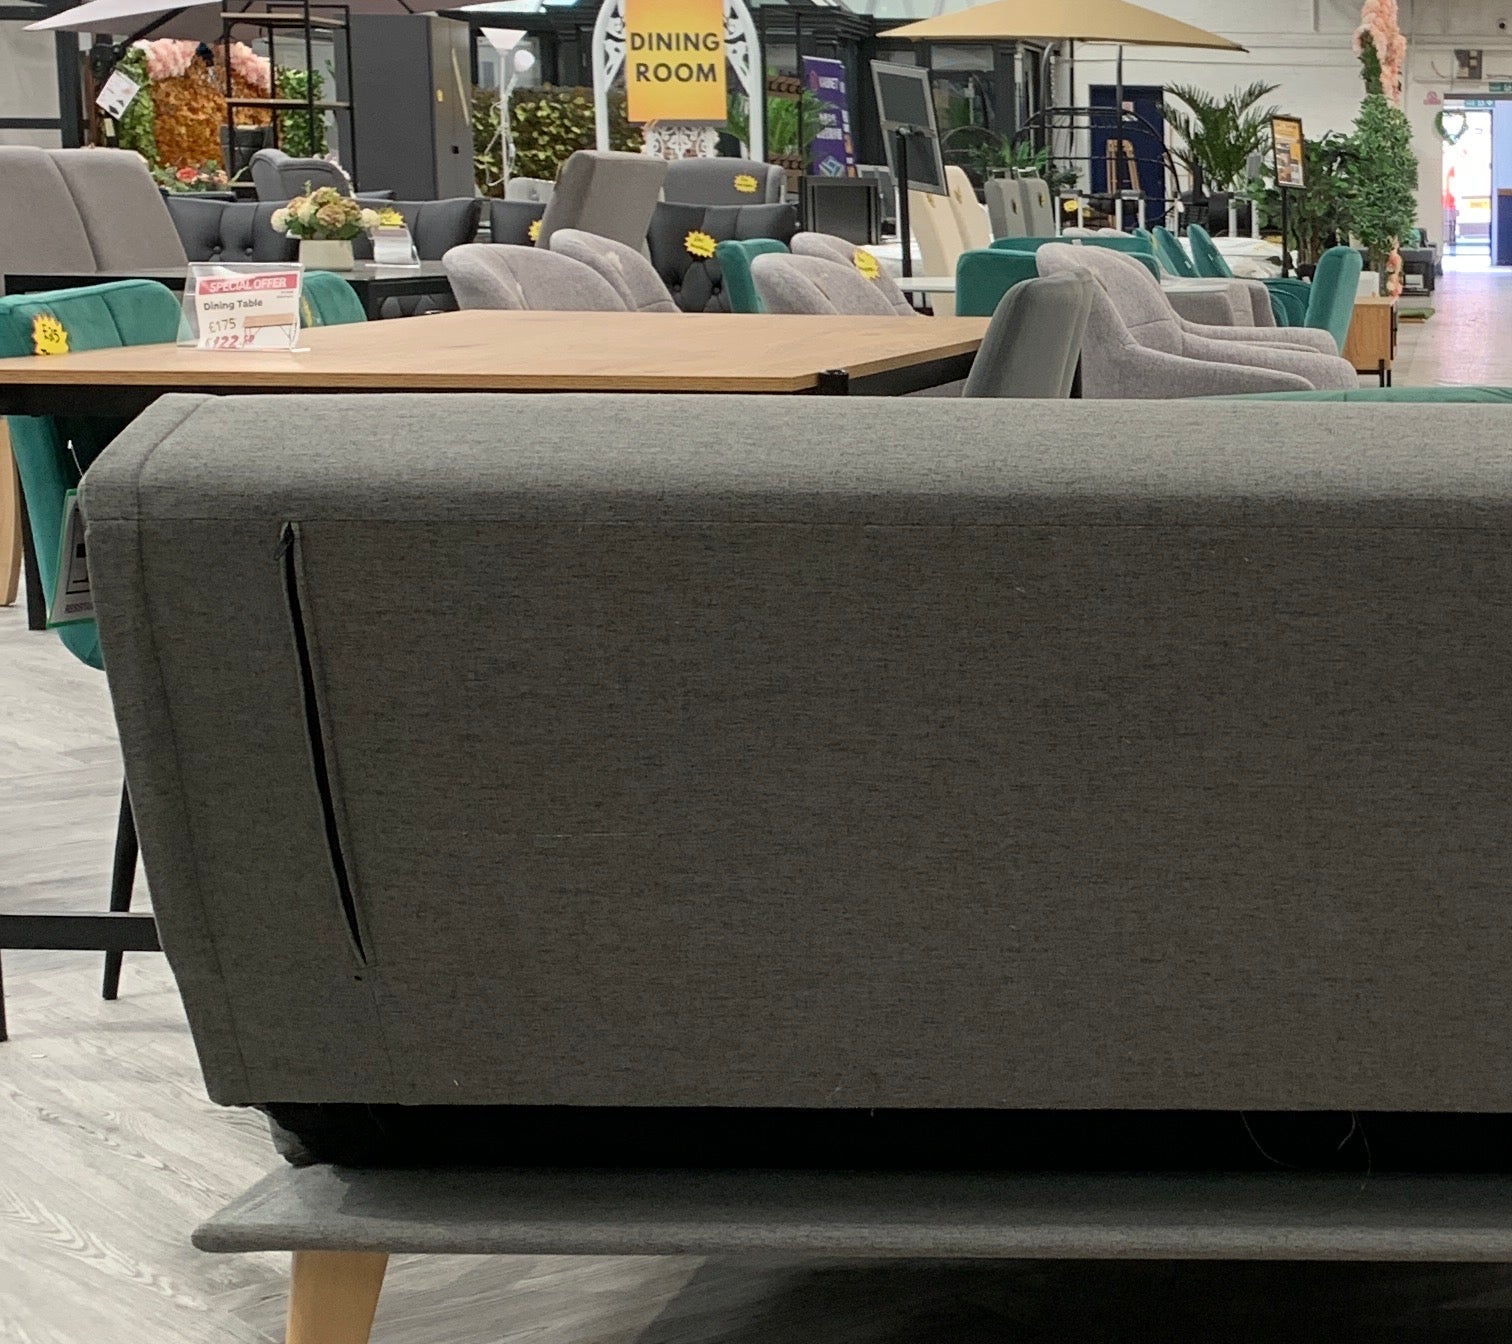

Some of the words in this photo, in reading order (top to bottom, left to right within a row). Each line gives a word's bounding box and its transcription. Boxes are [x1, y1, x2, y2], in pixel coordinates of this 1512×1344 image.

[630, 32, 720, 52] DINING
[636, 63, 717, 82] ROOM
[208, 278, 251, 293] SPECIAL
[253, 277, 287, 290] OFFER
[203, 300, 235, 311] Dining
[237, 298, 263, 308] Table
[208, 317, 236, 333] £175
